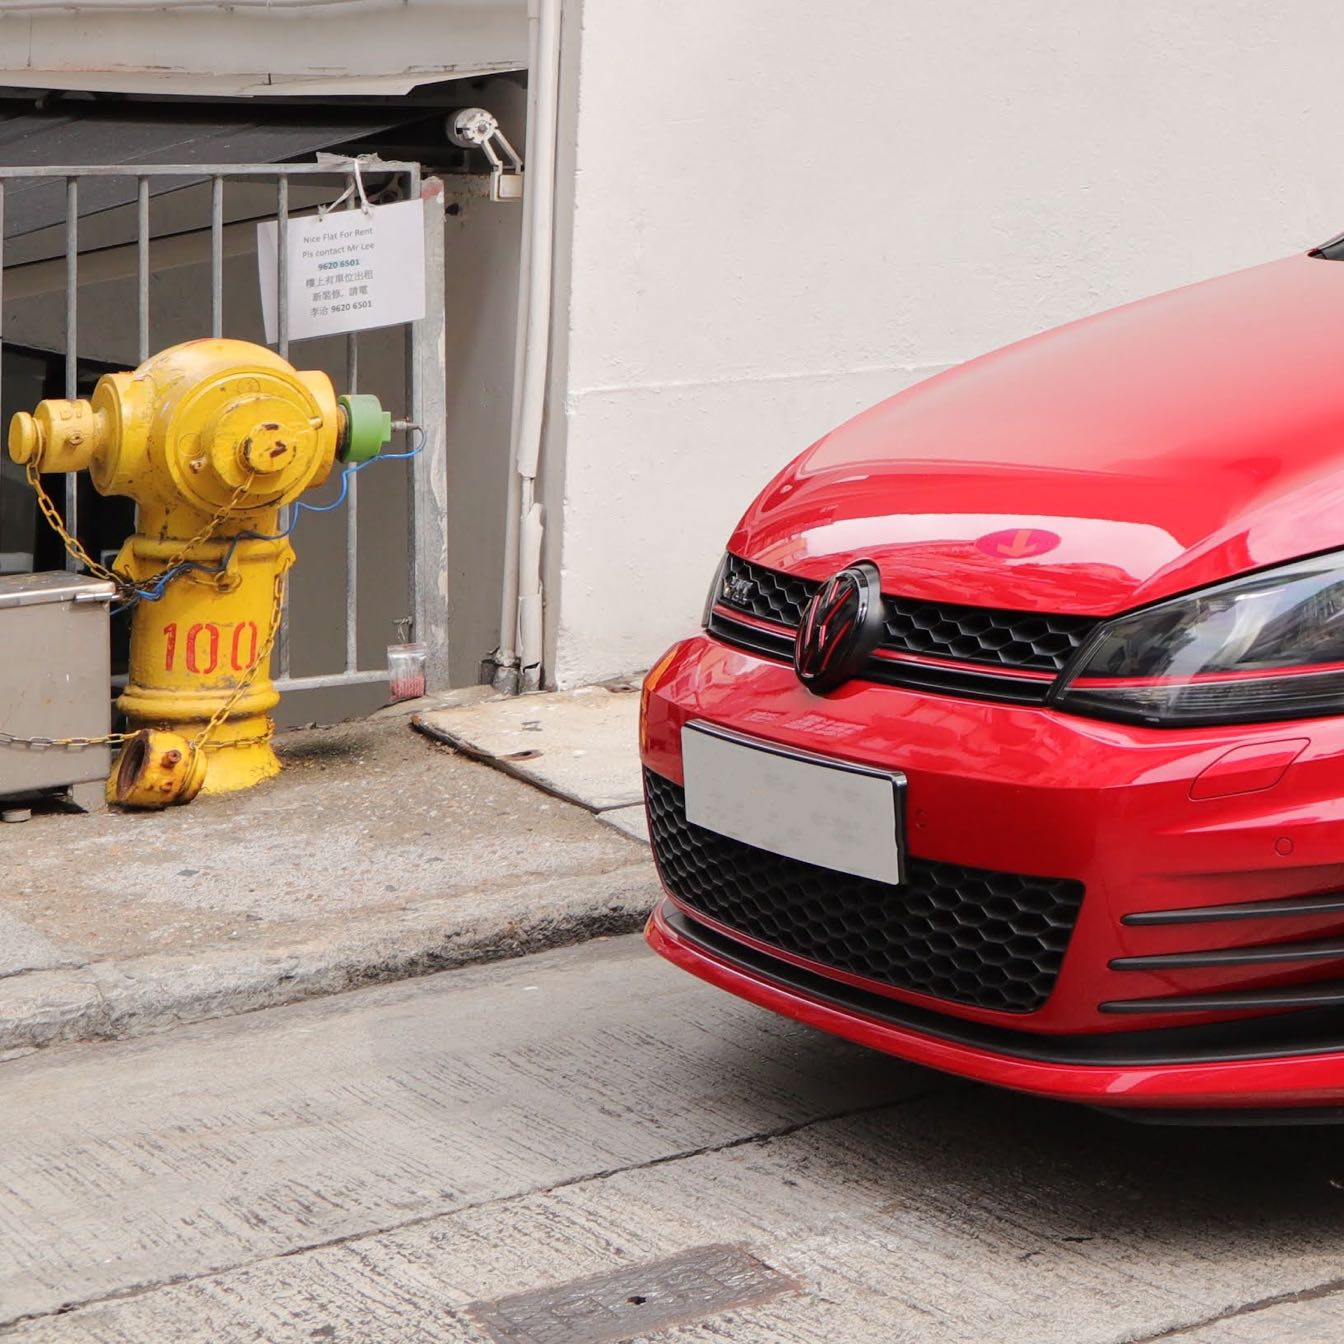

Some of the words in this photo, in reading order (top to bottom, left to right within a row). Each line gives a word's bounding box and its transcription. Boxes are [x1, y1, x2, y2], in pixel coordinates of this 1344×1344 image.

[303, 236, 321, 244] Nice
[323, 233, 338, 241] Flat
[339, 231, 353, 239] For
[354, 228, 373, 237] Rent
[315, 246, 345, 257] contact
[347, 244, 359, 252] Mr
[317, 261, 338, 271] 9620
[339, 259, 361, 268] 6501
[331, 303, 351, 313] 9620
[352, 300, 372, 310] 6501
[162, 622, 258, 675] 100
